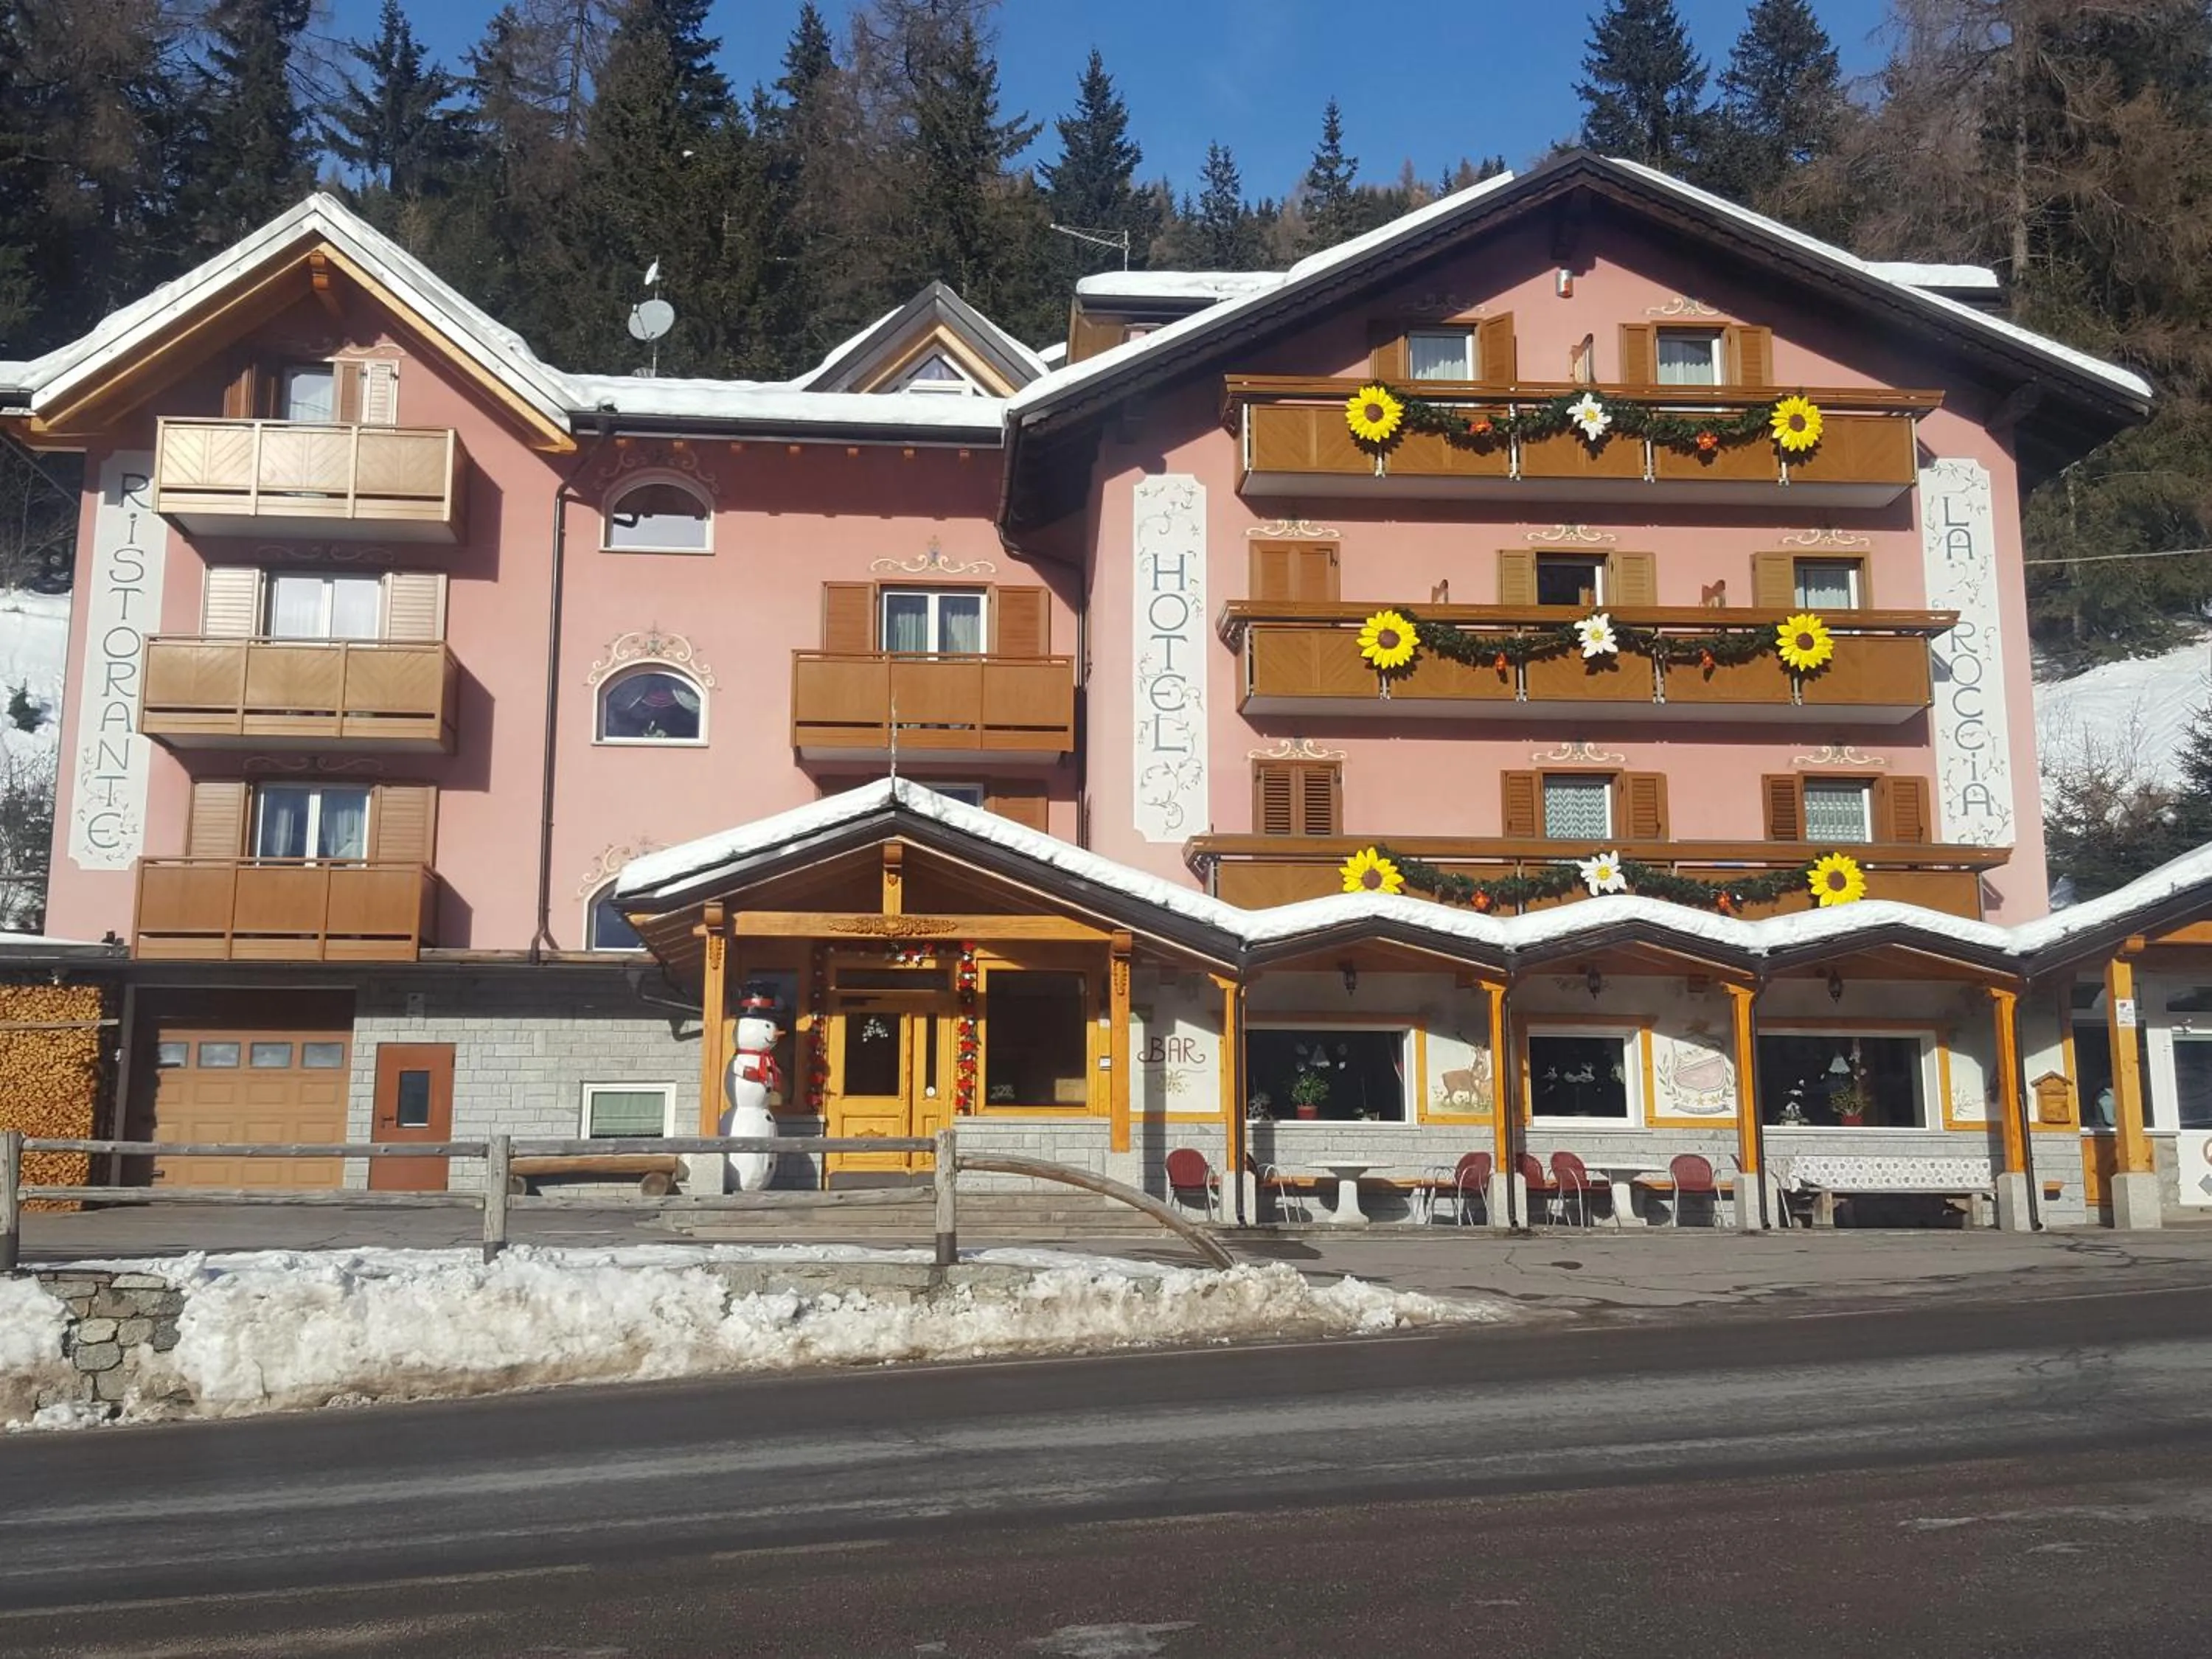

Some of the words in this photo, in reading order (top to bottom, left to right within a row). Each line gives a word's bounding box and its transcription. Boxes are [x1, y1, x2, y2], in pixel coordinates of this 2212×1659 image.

[1942, 496, 1975, 560] LA
[1149, 553, 1189, 753] HOTEL
[1137, 1037, 1206, 1064] BAR
